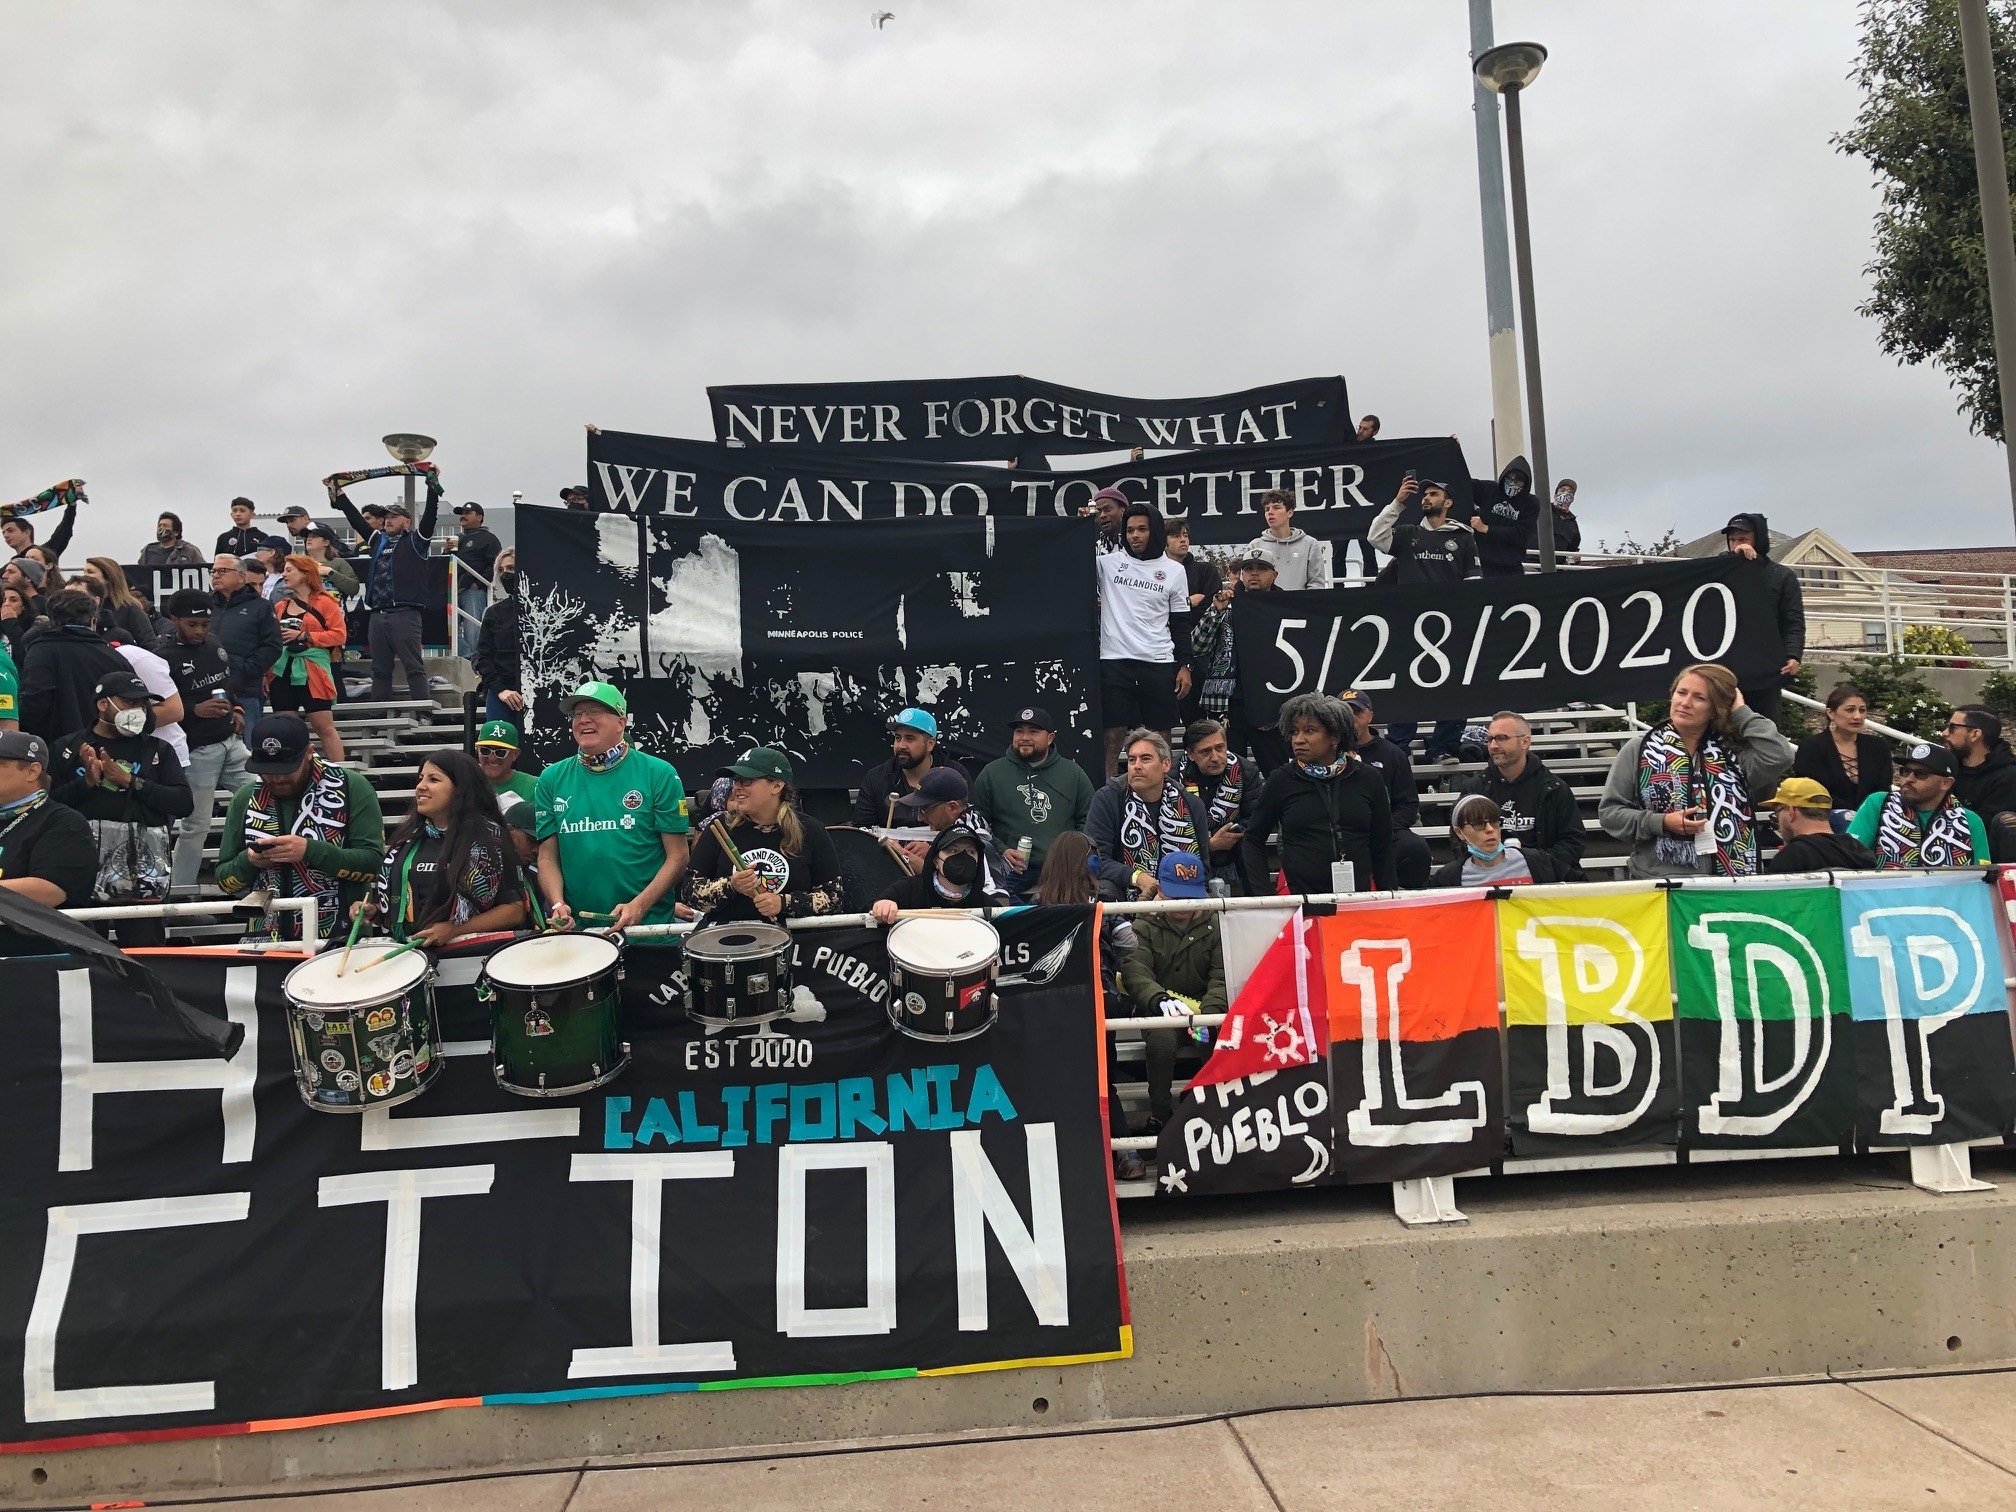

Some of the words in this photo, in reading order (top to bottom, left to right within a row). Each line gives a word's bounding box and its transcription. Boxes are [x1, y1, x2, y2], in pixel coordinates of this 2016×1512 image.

[723, 404, 907, 443] NEVER
[923, 397, 1120, 443] FORGET
[1136, 401, 1298, 446] WHAT
[593, 460, 697, 517] WE
[723, 476, 869, 522] CAN
[890, 481, 989, 518] DO
[1113, 576, 1164, 593] OAKLANDISH
[767, 630, 829, 639] MINNEAPOLIS
[832, 631, 864, 639] POLICE
[1265, 582, 1737, 694] 5/28/2020
[190, 673, 225, 690] Anthem
[559, 817, 618, 834] Anthem
[767, 852, 786, 874] ROOTS
[812, 946, 888, 1002] PUEBLO
[685, 1039, 739, 1071] EST
[750, 1039, 813, 1068] 2020
[605, 1064, 1018, 1148] CALIFORNIA
[1184, 1082, 1328, 1172] PUEBLO
[24, 1122, 1069, 1422] CTION
